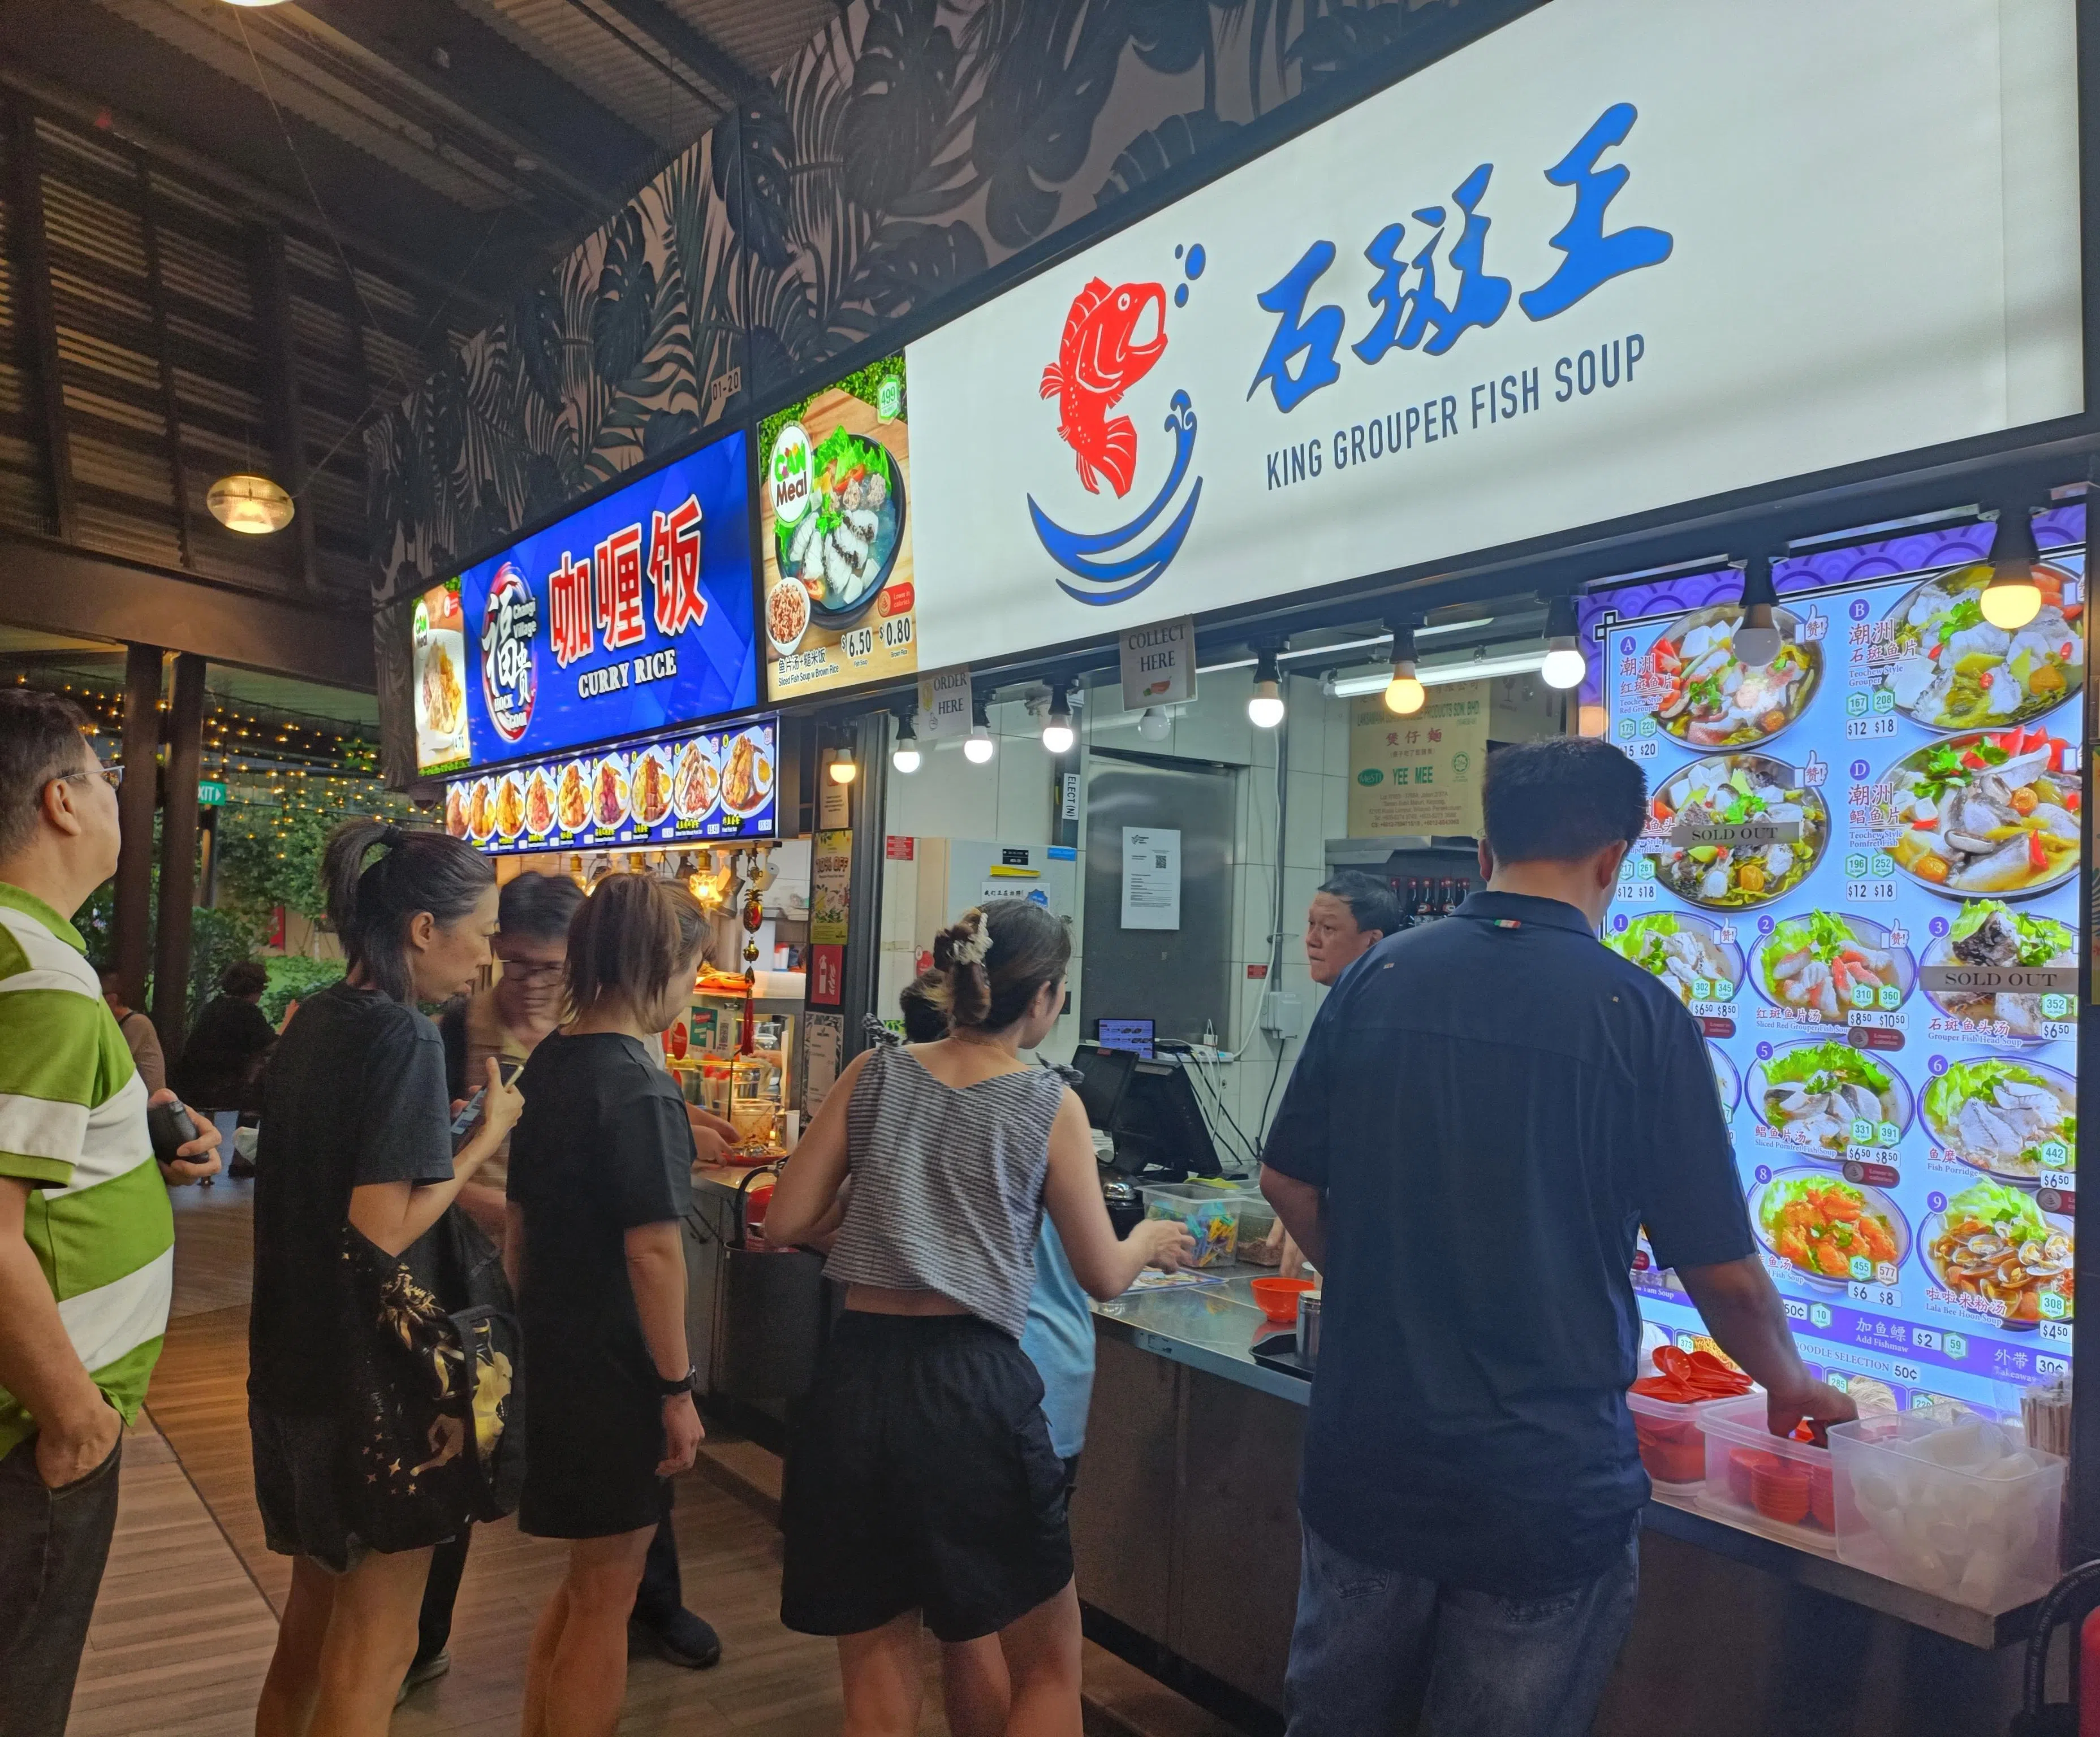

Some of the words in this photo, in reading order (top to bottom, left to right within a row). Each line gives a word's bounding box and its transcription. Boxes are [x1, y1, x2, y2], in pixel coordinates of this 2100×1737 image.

[712, 371, 739, 401] 01-20
[881, 386, 896, 405] 499
[1267, 439, 1322, 491] KING
[1334, 395, 1458, 470] GROUPER
[1472, 366, 1540, 429] FISH
[1555, 334, 1645, 403] SOUP
[776, 474, 808, 507] Meal
[550, 494, 707, 669] 咖喱饭
[513, 597, 536, 619] Changi
[1856, 603, 1865, 617] B
[513, 621, 537, 639] Village
[1129, 624, 1187, 650] COLLECT
[1849, 619, 1894, 645] 潮洲
[1624, 639, 1633, 651] A
[1850, 640, 1917, 663] 石斑鱼片
[1140, 651, 1176, 672] HERE
[1620, 654, 1655, 676] 潮洲
[578, 662, 628, 699] CURRY
[636, 649, 677, 685] RICE
[779, 677, 790, 686] Sliced
[800, 672, 810, 682] Soup
[816, 668, 829, 677] Brown
[830, 665, 839, 674] Rice
[1849, 668, 1884, 679] Teochew
[1884, 664, 1903, 675] Style
[933, 673, 967, 691] ORDER
[1620, 674, 1674, 694] 红斑鱼片
[1849, 677, 1881, 688] Grouper
[494, 694, 514, 712] HOCK
[938, 698, 964, 715] HERE
[1620, 697, 1646, 706] Teochew
[1648, 695, 1662, 705] Style
[1851, 698, 1865, 707] 167
[1877, 695, 1891, 705] 208
[1633, 706, 1658, 714] Grouper
[1622, 723, 1633, 732] 175
[1642, 721, 1654, 730] 220
[1848, 721, 1866, 736] $12
[1875, 719, 1894, 733] $18
[1641, 744, 1655, 756] $20
[1393, 767, 1408, 785] YEE
[1415, 766, 1433, 784] MEE
[1855, 763, 1866, 776] D
[198, 785, 215, 801] XIT
[1067, 776, 1076, 803] ELECT
[1848, 782, 1894, 805] 潮洲
[1066, 804, 1076, 817] (N)
[1849, 806, 1900, 824] 鲳鱼片
[1692, 828, 1735, 841] SOLD
[1741, 827, 1778, 839] OUT
[1884, 830, 1903, 839] Style
[1849, 839, 1880, 848] Pomfret
[816, 857, 833, 872] 10%
[834, 856, 848, 872] OFF
[1849, 859, 1864, 868] 196
[1875, 859, 1891, 868] 252
[1618, 886, 1633, 898] $12
[1639, 886, 1654, 898] $18
[1848, 885, 1866, 897] $12
[1875, 884, 1893, 897] $18
[1762, 920, 1769, 930] 2
[1934, 921, 1943, 934] 3
[1946, 973, 2001, 986] SOLD
[2008, 973, 2058, 987] OUT
[1718, 984, 1731, 992] 345
[1856, 990, 1871, 999] 310
[1882, 991, 1898, 1000] 360
[2047, 999, 2064, 1009] 352
[1757, 1008, 1821, 1023] 红斑鱼片汤
[1790, 1022, 1818, 1032] Grouper
[1929, 1018, 2010, 1035] 石斑鱼头汤
[1928, 1032, 1959, 1042] Grouper
[2002, 1038, 2023, 1047] Soup
[1761, 1046, 1768, 1057] 5
[1933, 1059, 1942, 1071] 6
[1756, 1126, 1806, 1144] 鲳鱼片汤
[1855, 1125, 1870, 1134] 331
[1882, 1128, 1896, 1138] 391
[1755, 1139, 1774, 1148] Sliced
[1775, 1141, 1801, 1152] Pomfret
[1803, 1144, 1818, 1153] Fish
[1819, 1147, 1836, 1157] Soup
[2046, 1148, 2064, 1159] 442
[1760, 1169, 1767, 1180] 8
[1927, 1164, 1943, 1172] Fish
[1945, 1165, 1978, 1177] Porridge
[1933, 1196, 1942, 1209] 9
[1854, 1261, 1869, 1272] 455
[1879, 1267, 1895, 1277] 577
[1771, 1271, 1786, 1279] Fish
[1787, 1274, 1804, 1285] Soup
[1658, 1290, 1674, 1300] Soup
[1853, 1286, 1867, 1300] $6
[1879, 1292, 1893, 1306] $8
[1926, 1287, 2007, 1315] 啦啦米粉汤
[2044, 1298, 2062, 1310] 308
[1817, 1310, 1826, 1319] 10
[1926, 1303, 1942, 1312] Lala
[1943, 1306, 1957, 1315] Bee
[1959, 1309, 1981, 1320] Hoon
[1982, 1314, 2002, 1327] Soup
[1856, 1317, 1907, 1342] 加鱼鳔
[1680, 1339, 1692, 1348] 373
[1856, 1334, 1872, 1345] Add
[1873, 1339, 1909, 1353] Fishmaw
[1917, 1333, 1932, 1347] $2
[1950, 1339, 1961, 1350] 59
[1797, 1342, 1832, 1358] OODLE
[1835, 1351, 1890, 1372] SELECTION
[1994, 1349, 2028, 1369] 外带
[1895, 1364, 1918, 1380] 50¢
[1831, 1378, 1845, 1388] 285
